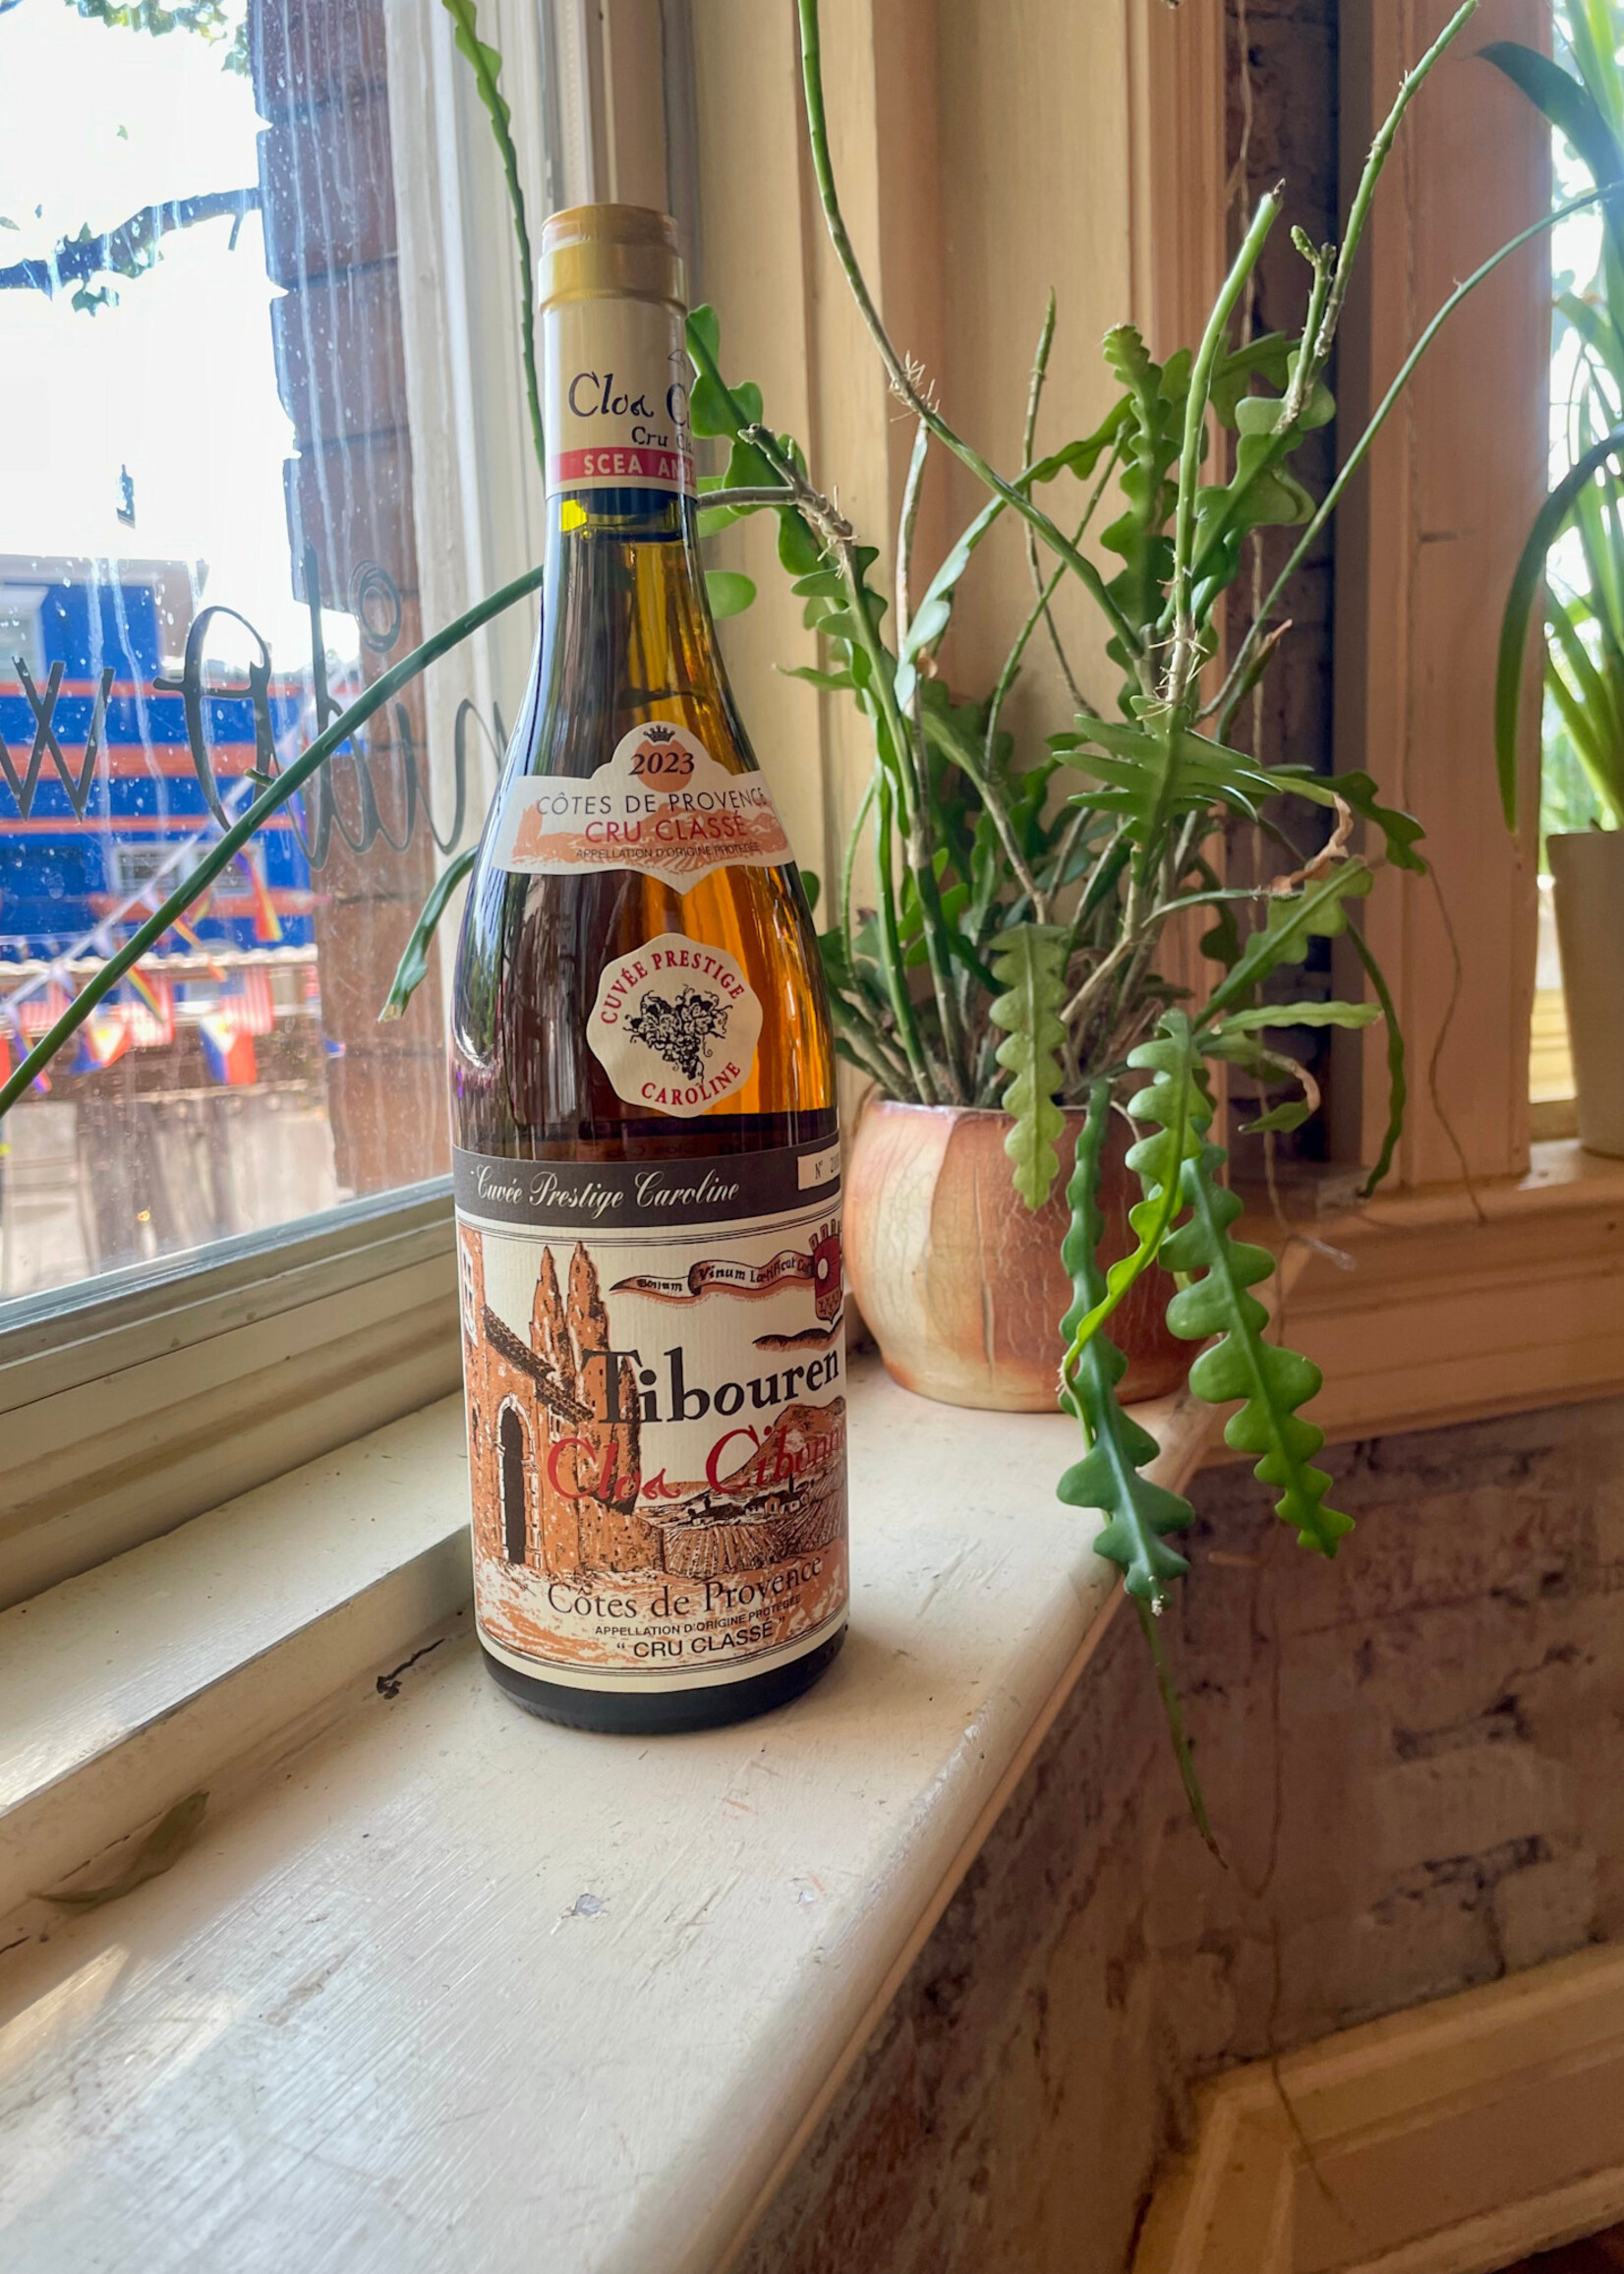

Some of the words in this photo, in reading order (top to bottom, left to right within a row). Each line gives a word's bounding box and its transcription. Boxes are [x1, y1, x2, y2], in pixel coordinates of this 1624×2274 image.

[568, 371, 654, 419] Clos
[631, 426, 667, 448] Cru
[583, 453, 643, 476] SCEA
[628, 751, 695, 776] 2023
[536, 790, 611, 815] CÔTES
[625, 793, 657, 814] DE
[668, 787, 767, 813] PROVENCE
[585, 821, 642, 844] CRU
[655, 809, 747, 842] CLASSÉ
[575, 846, 653, 860] APPELLATION
[601, 960, 649, 1024] CUVÉE
[651, 949, 745, 1000] PRESTIGE
[640, 1061, 740, 1107] CAROLINE
[473, 1164, 524, 1204] Cuvée
[528, 1170, 625, 1220] Prestige
[634, 1167, 740, 1208] Caroline
[699, 1264, 746, 1281] Vinum
[581, 1346, 840, 1425] Tibouren
[547, 1436, 681, 1501] Clos
[548, 1582, 637, 1619] Côtes
[650, 1585, 691, 1618] de
[704, 1556, 822, 1613] Provence
[595, 1624, 680, 1636] APPELLATION
[684, 1613, 746, 1633] D'ORIGINE
[633, 1639, 683, 1659] CRU
[690, 1616, 774, 1654] CLASSÉ
